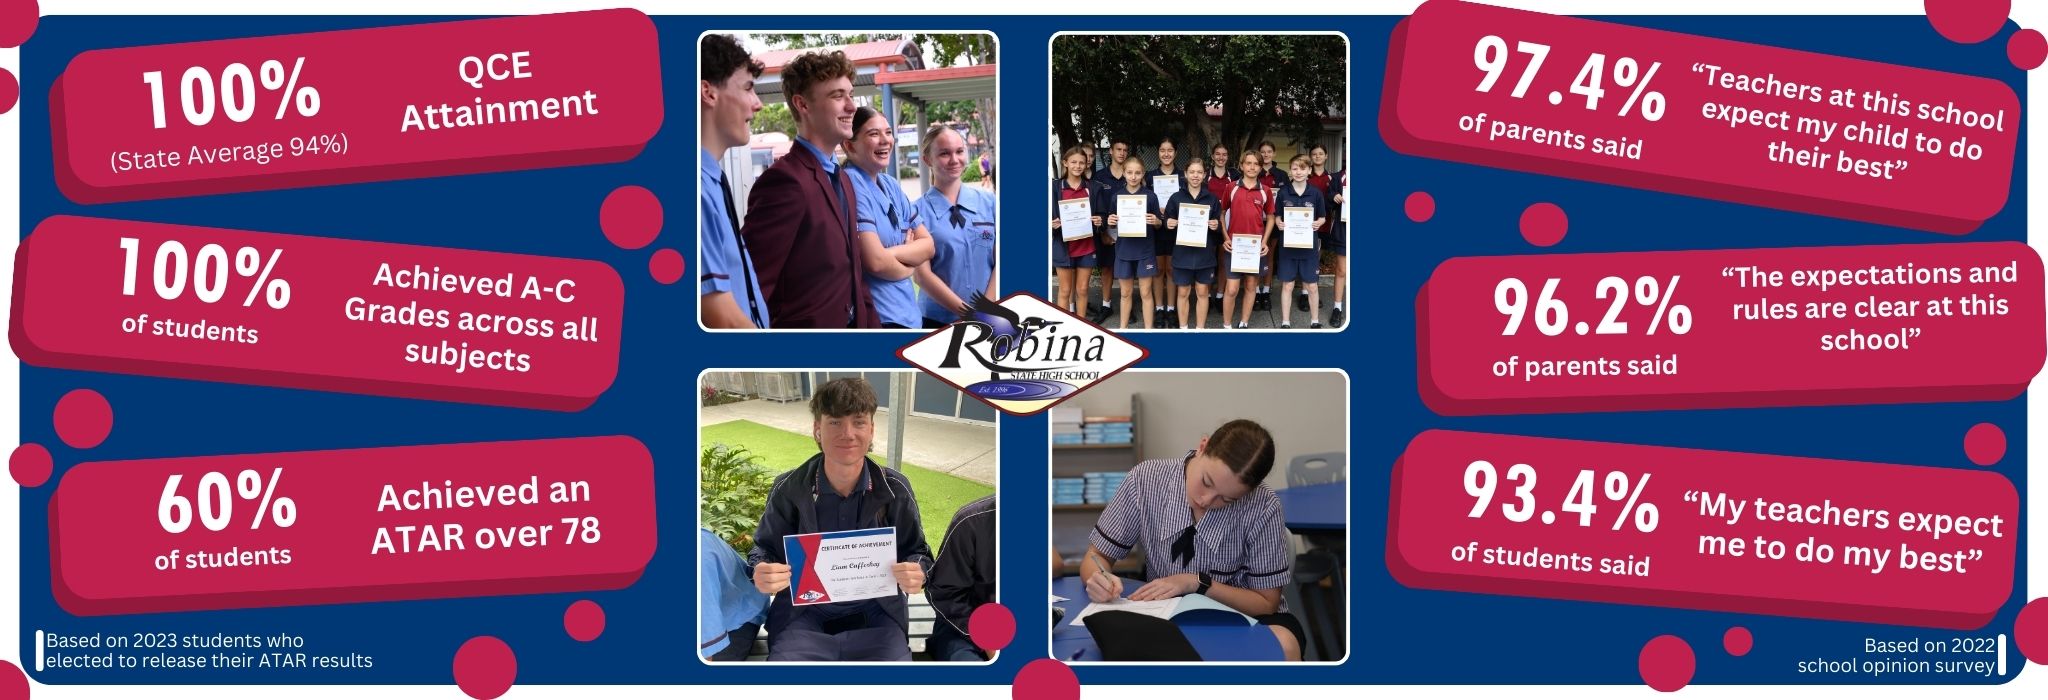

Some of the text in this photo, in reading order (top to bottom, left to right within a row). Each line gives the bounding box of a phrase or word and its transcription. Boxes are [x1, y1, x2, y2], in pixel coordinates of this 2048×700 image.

[458, 50, 533, 89] QCE
[1473, 34, 1667, 122] 97.4%
[142, 56, 321, 129] 100%
[400, 89, 599, 133] Attainment
[1828, 88, 1856, 109] at
[1862, 89, 1911, 117] this
[1916, 101, 2004, 133] school
[1458, 112, 1643, 161] of parents said
[1701, 102, 1983, 161] expect my child to do
[110, 132, 348, 174] (State Average 94%)
[1767, 140, 1832, 169] their
[119, 236, 291, 310] 100%
[372, 262, 576, 303] Achieved A-C
[1790, 262, 1962, 292] expectations
[1968, 260, 2018, 284] and
[344, 296, 598, 343] Grades across all
[1493, 274, 1693, 337] 96.2%
[1733, 293, 2009, 321] rules are clear at this
[121, 313, 259, 345] of students
[938, 320, 1105, 373] Robina
[404, 339, 531, 374] subjects
[1010, 371, 1037, 380] STATE
[1039, 371, 1063, 380] HIGH
[1492, 353, 1678, 382] of parents said
[157, 467, 297, 534] 60%
[376, 475, 591, 512] Achieved an
[1463, 459, 1660, 533] 93.4%
[370, 516, 601, 555] ATAR over 78
[1753, 497, 1890, 530] teachers
[1898, 511, 2004, 540] expect
[154, 546, 292, 571] of students
[821, 544, 851, 552] CERTIFICATE
[858, 541, 892, 549] ACHIEVEMENT
[1451, 541, 1651, 577] of students said
[1698, 535, 1746, 557] me
[1753, 535, 1786, 560] to
[1795, 536, 1835, 564] do
[1843, 545, 1892, 575] my
[46, 632, 304, 649] Based on 2023 students who
[1865, 637, 1996, 653] Based on 2022
[46, 652, 373, 669] elected to release their ATAR results
[1797, 657, 1996, 678] school opinion survey
